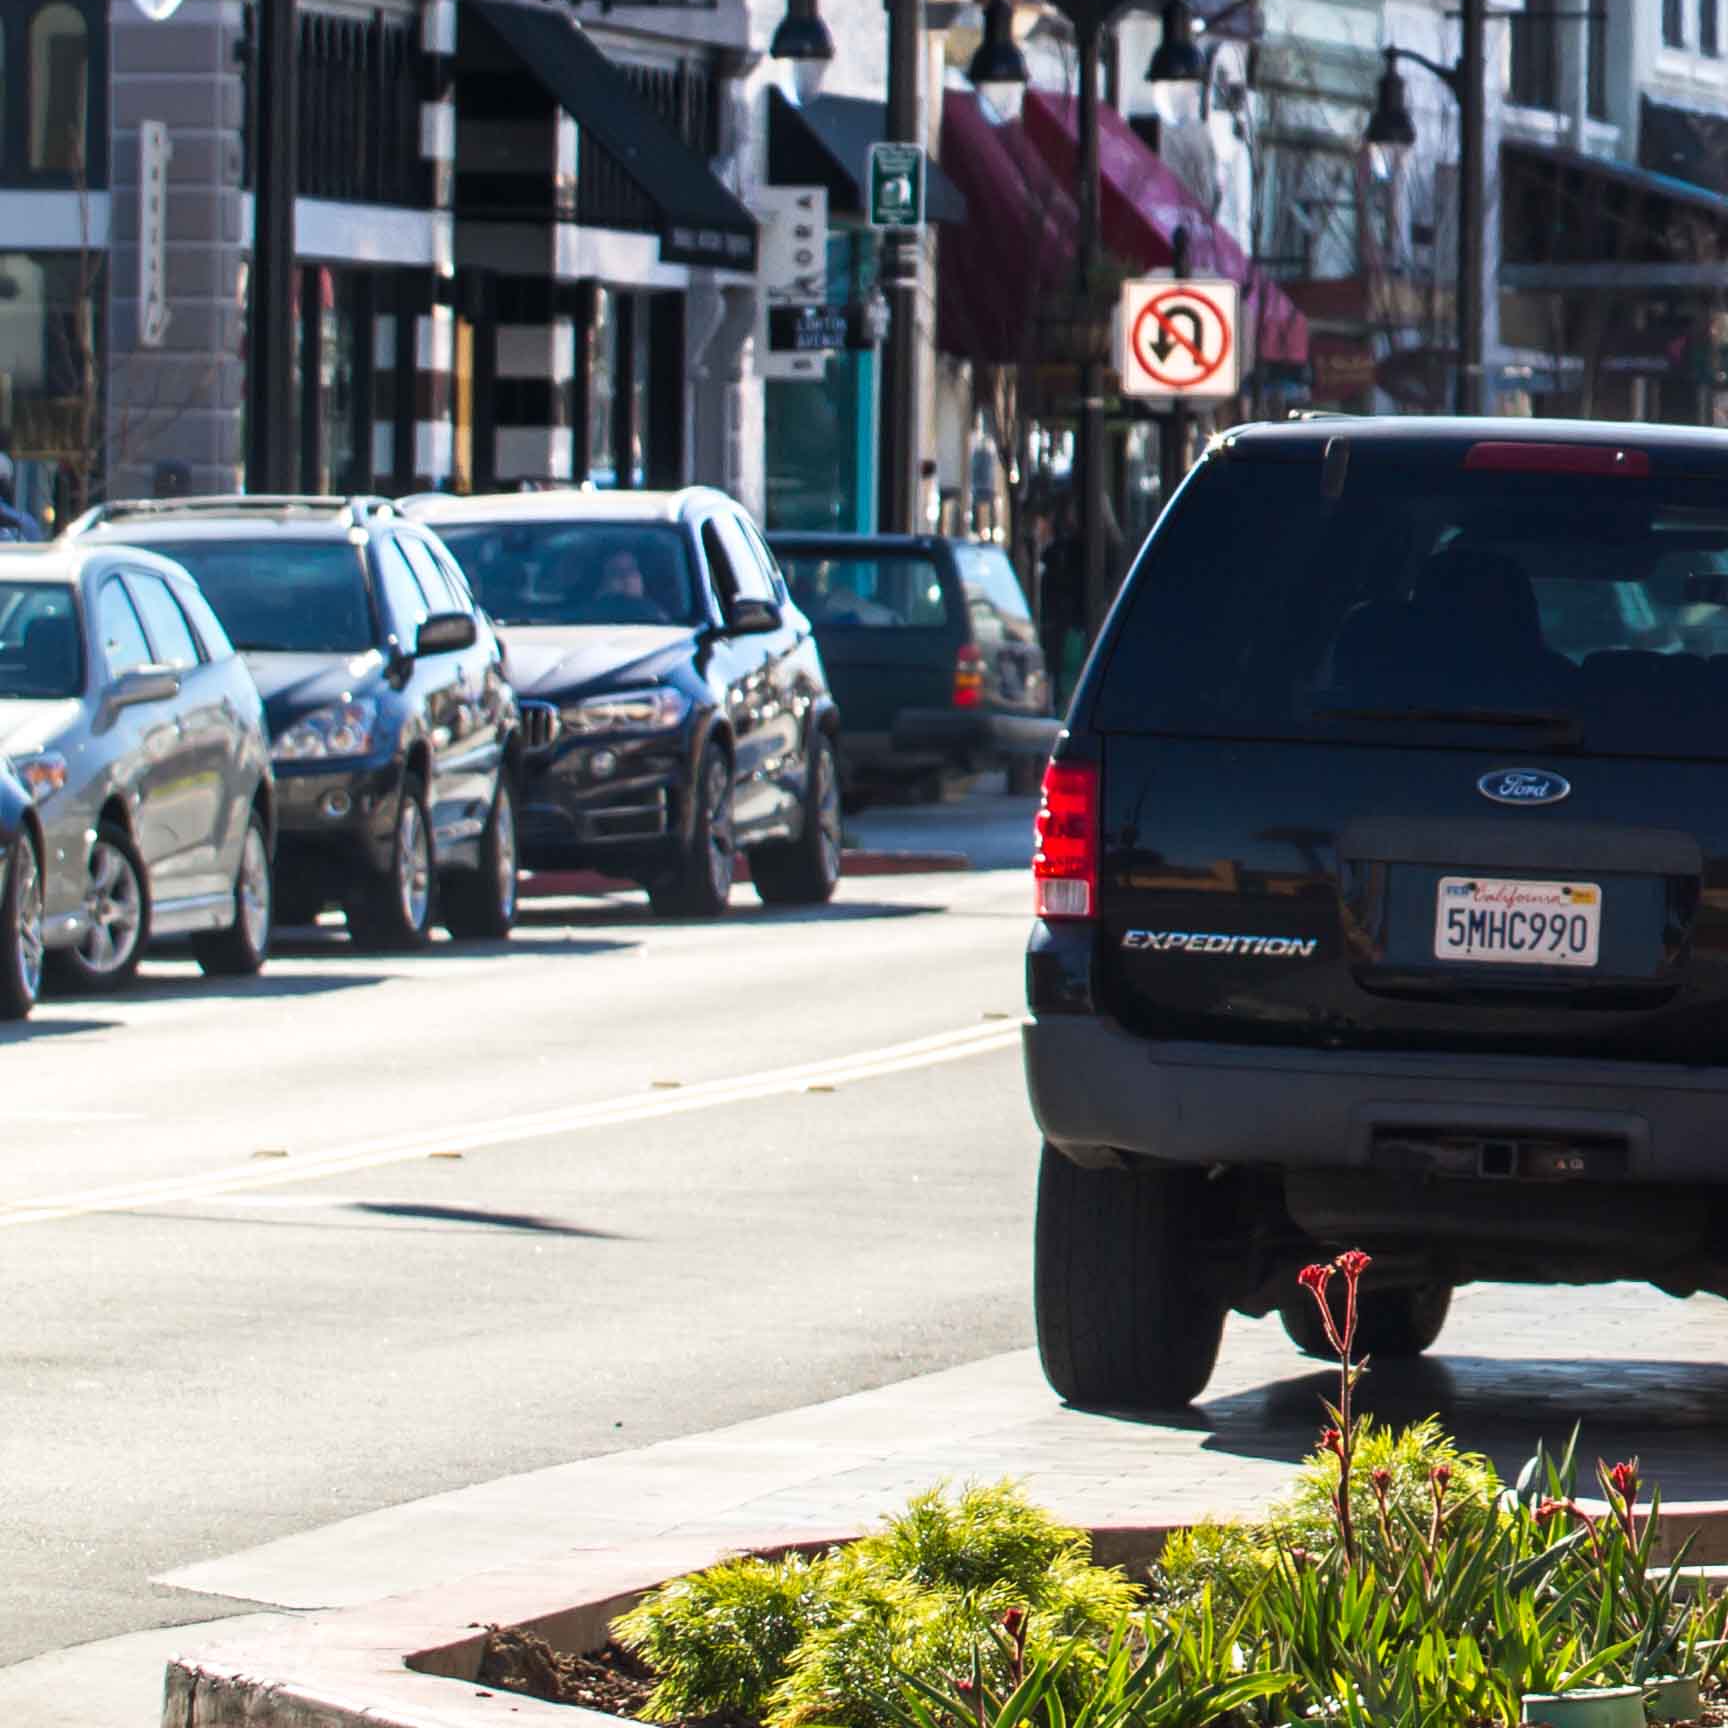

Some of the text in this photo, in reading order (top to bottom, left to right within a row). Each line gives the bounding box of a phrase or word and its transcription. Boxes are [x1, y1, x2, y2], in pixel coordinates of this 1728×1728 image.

[1499, 774, 1551, 798] Ford
[1472, 882, 1561, 910] California
[1121, 928, 1318, 957] EXPEDITION
[1447, 908, 1588, 952] 5MHC990
